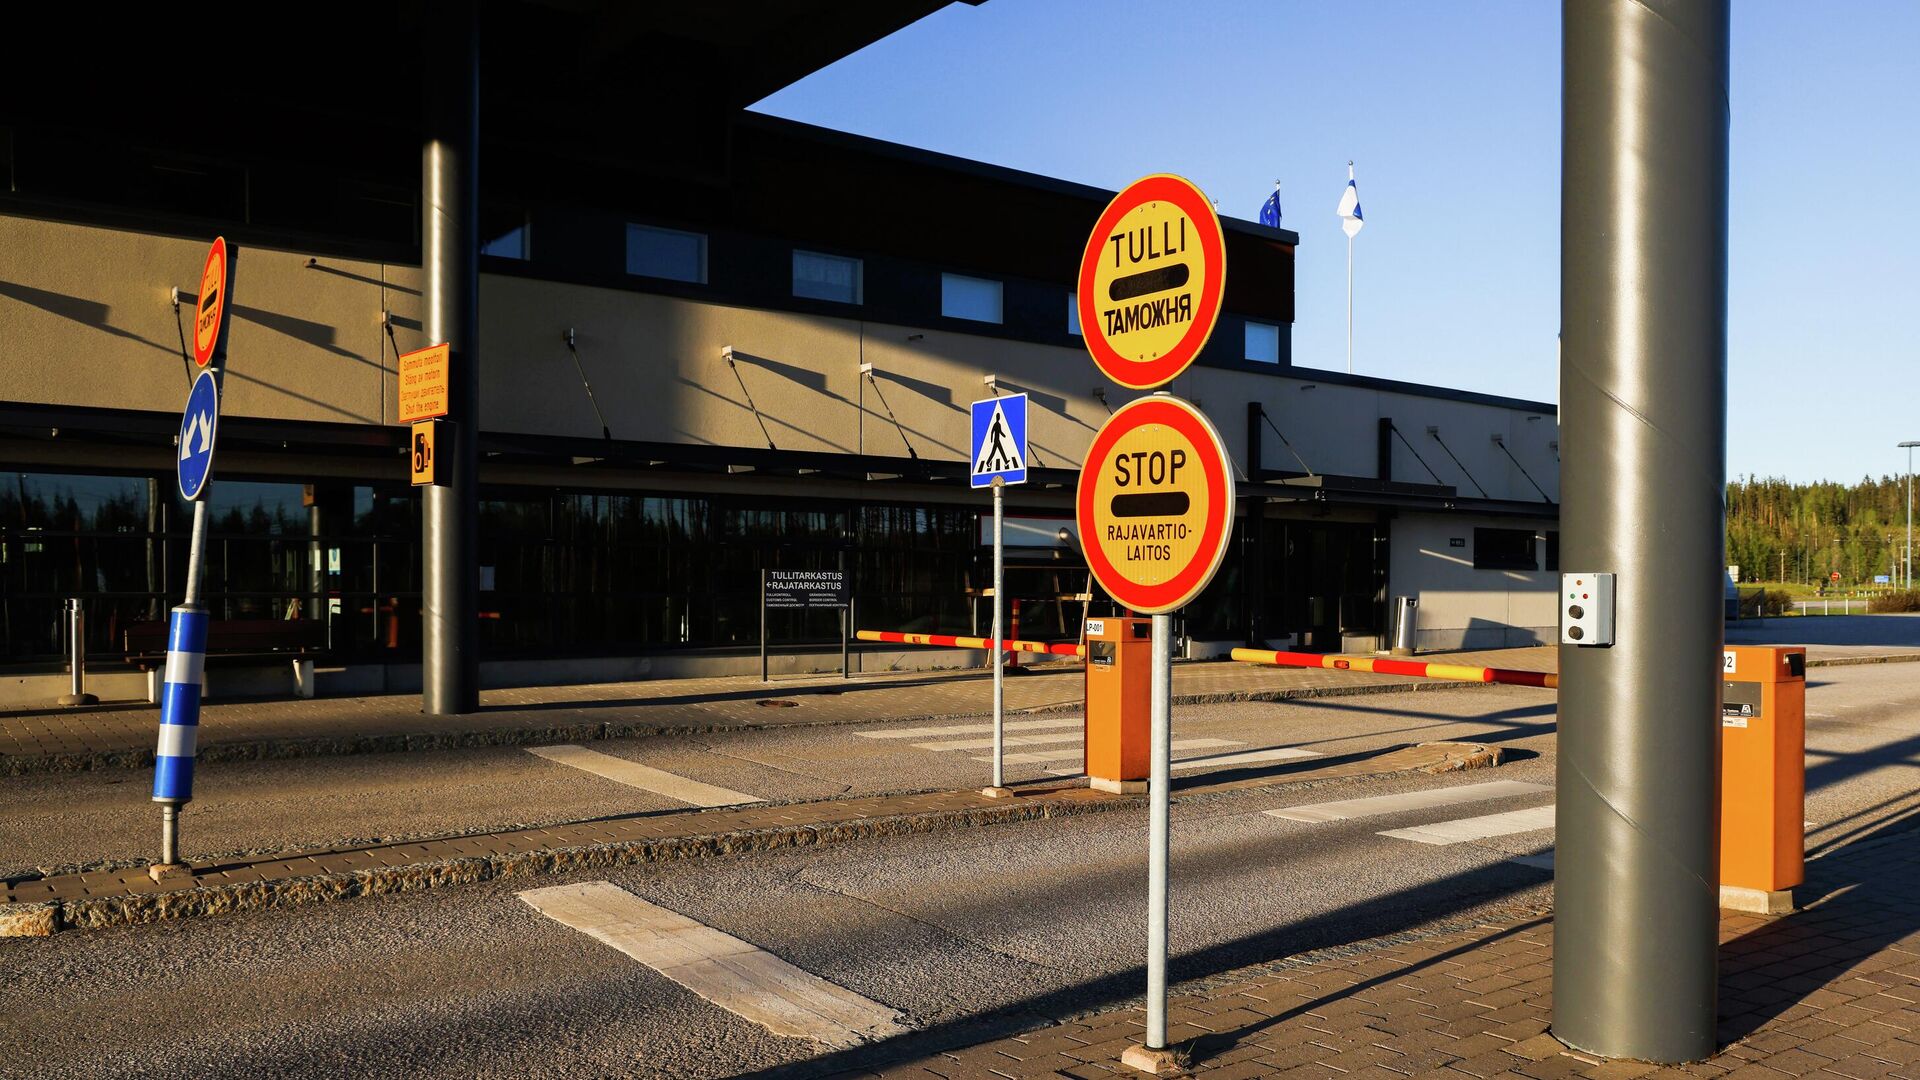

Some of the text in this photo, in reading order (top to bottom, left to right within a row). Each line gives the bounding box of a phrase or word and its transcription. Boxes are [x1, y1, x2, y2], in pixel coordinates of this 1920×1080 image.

[1110, 217, 1185, 268] TULLI
[1104, 293, 1192, 337] ТАМОЖНЯ
[1114, 449, 1186, 487] STOP
[1107, 523, 1192, 541] RAJAVARTIO-
[1127, 545, 1171, 561] LAITOS
[772, 571, 843, 580] TULLITARKASTUS
[772, 581, 842, 590] RAJATARKASTUS
